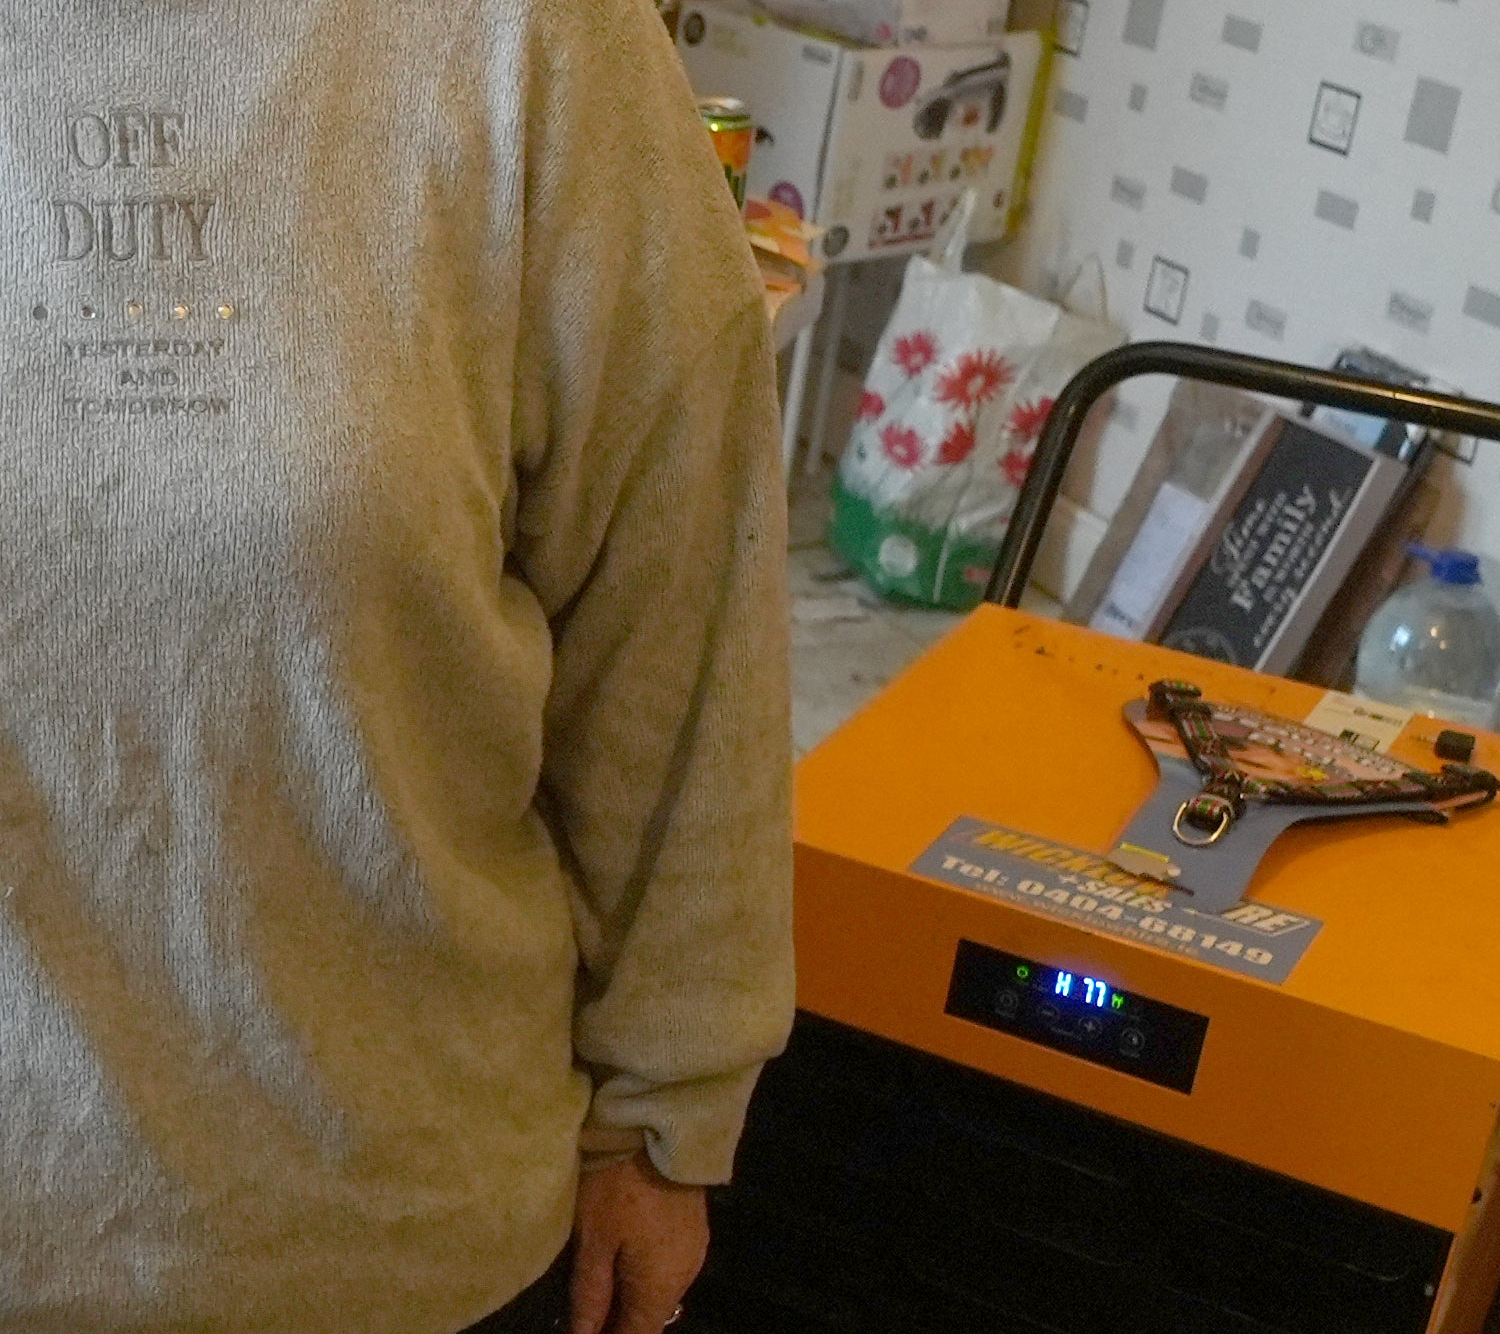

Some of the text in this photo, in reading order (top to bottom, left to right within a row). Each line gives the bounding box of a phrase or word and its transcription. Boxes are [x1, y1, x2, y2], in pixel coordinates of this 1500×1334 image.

[67, 112, 185, 169] OFF
[52, 199, 216, 262] DUTY
[63, 395, 233, 416] TOMORROW
[119, 368, 178, 387] AND
[940, 854, 1275, 966] Tel: 0404-68149
